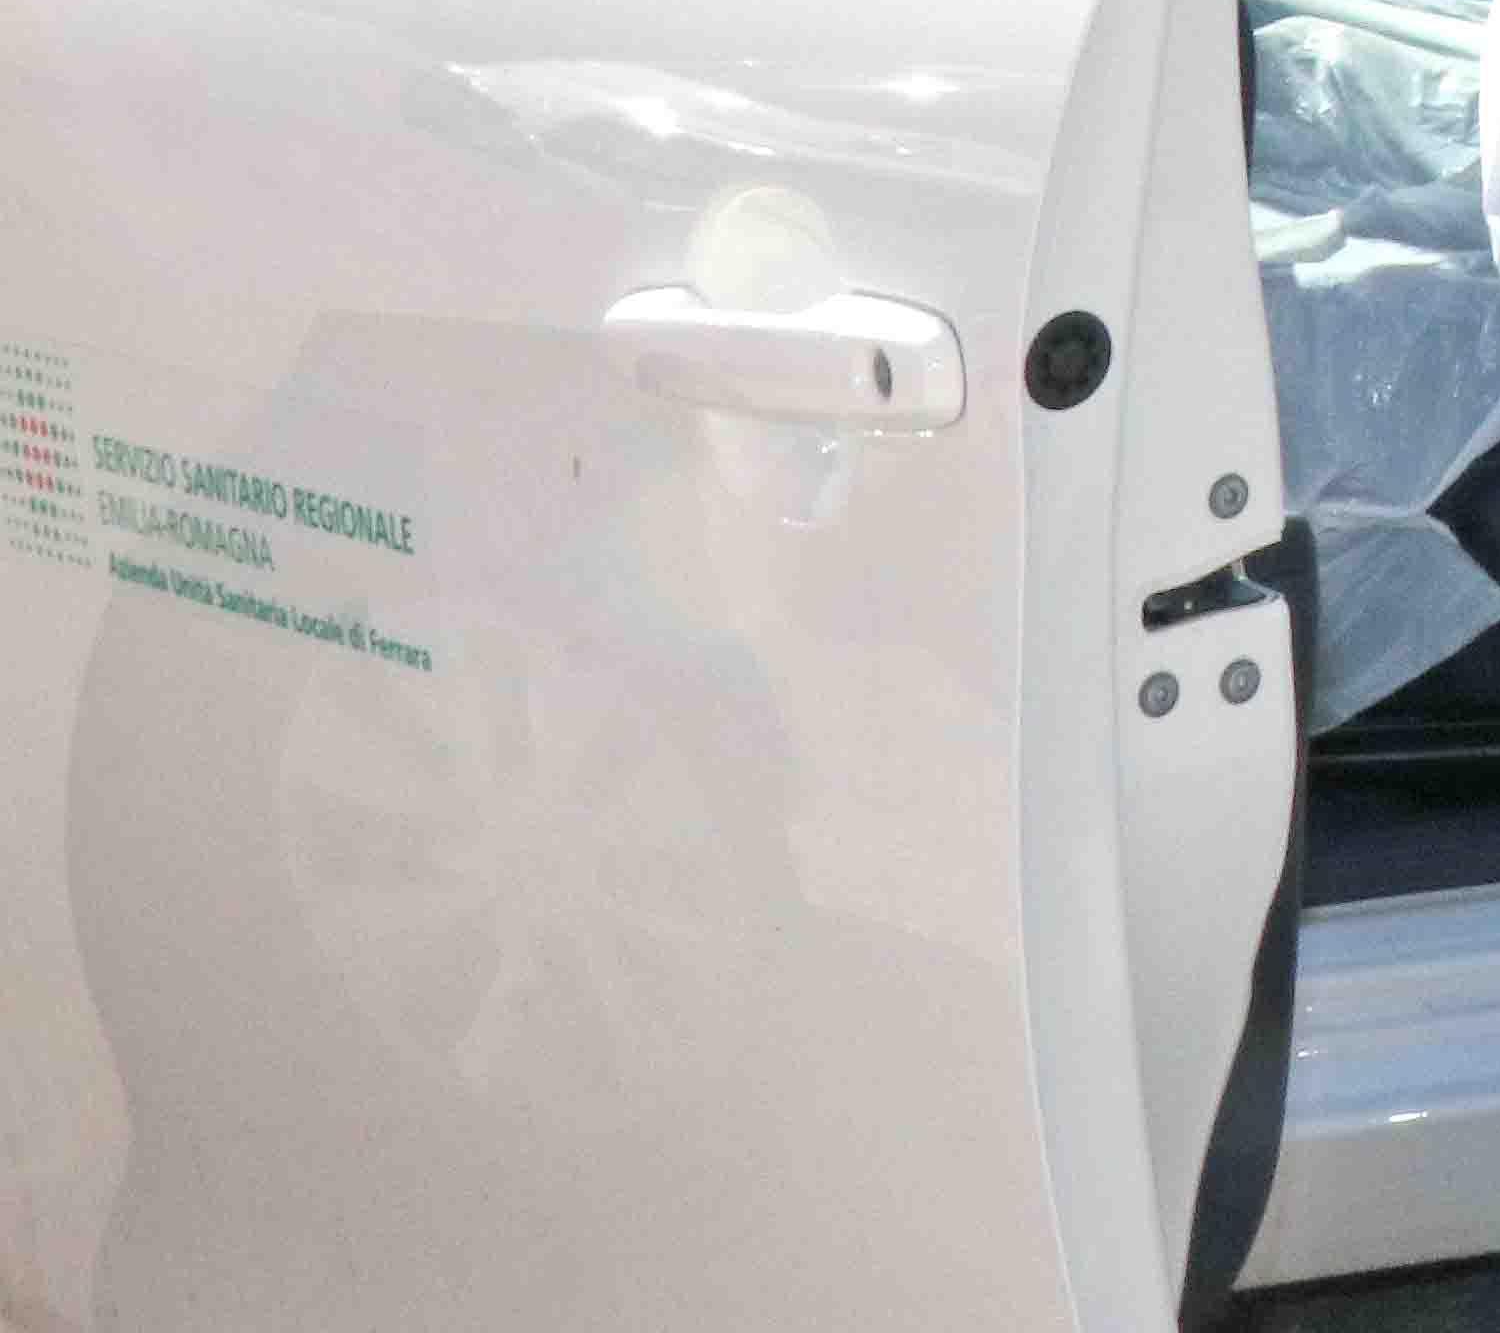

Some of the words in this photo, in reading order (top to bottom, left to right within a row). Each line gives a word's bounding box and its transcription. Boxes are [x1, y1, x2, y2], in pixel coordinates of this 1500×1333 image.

[93, 435, 176, 488] SERVIZIO
[181, 457, 287, 519] SANITARIO
[293, 488, 414, 555] REGIONALE
[98, 490, 275, 571] EMILIA-ROMAGNA
[110, 552, 168, 591] Azienda
[216, 583, 288, 627] Sanitaria
[290, 606, 344, 645] Locale
[350, 622, 366, 652] di
[369, 628, 432, 671] Ferrara
